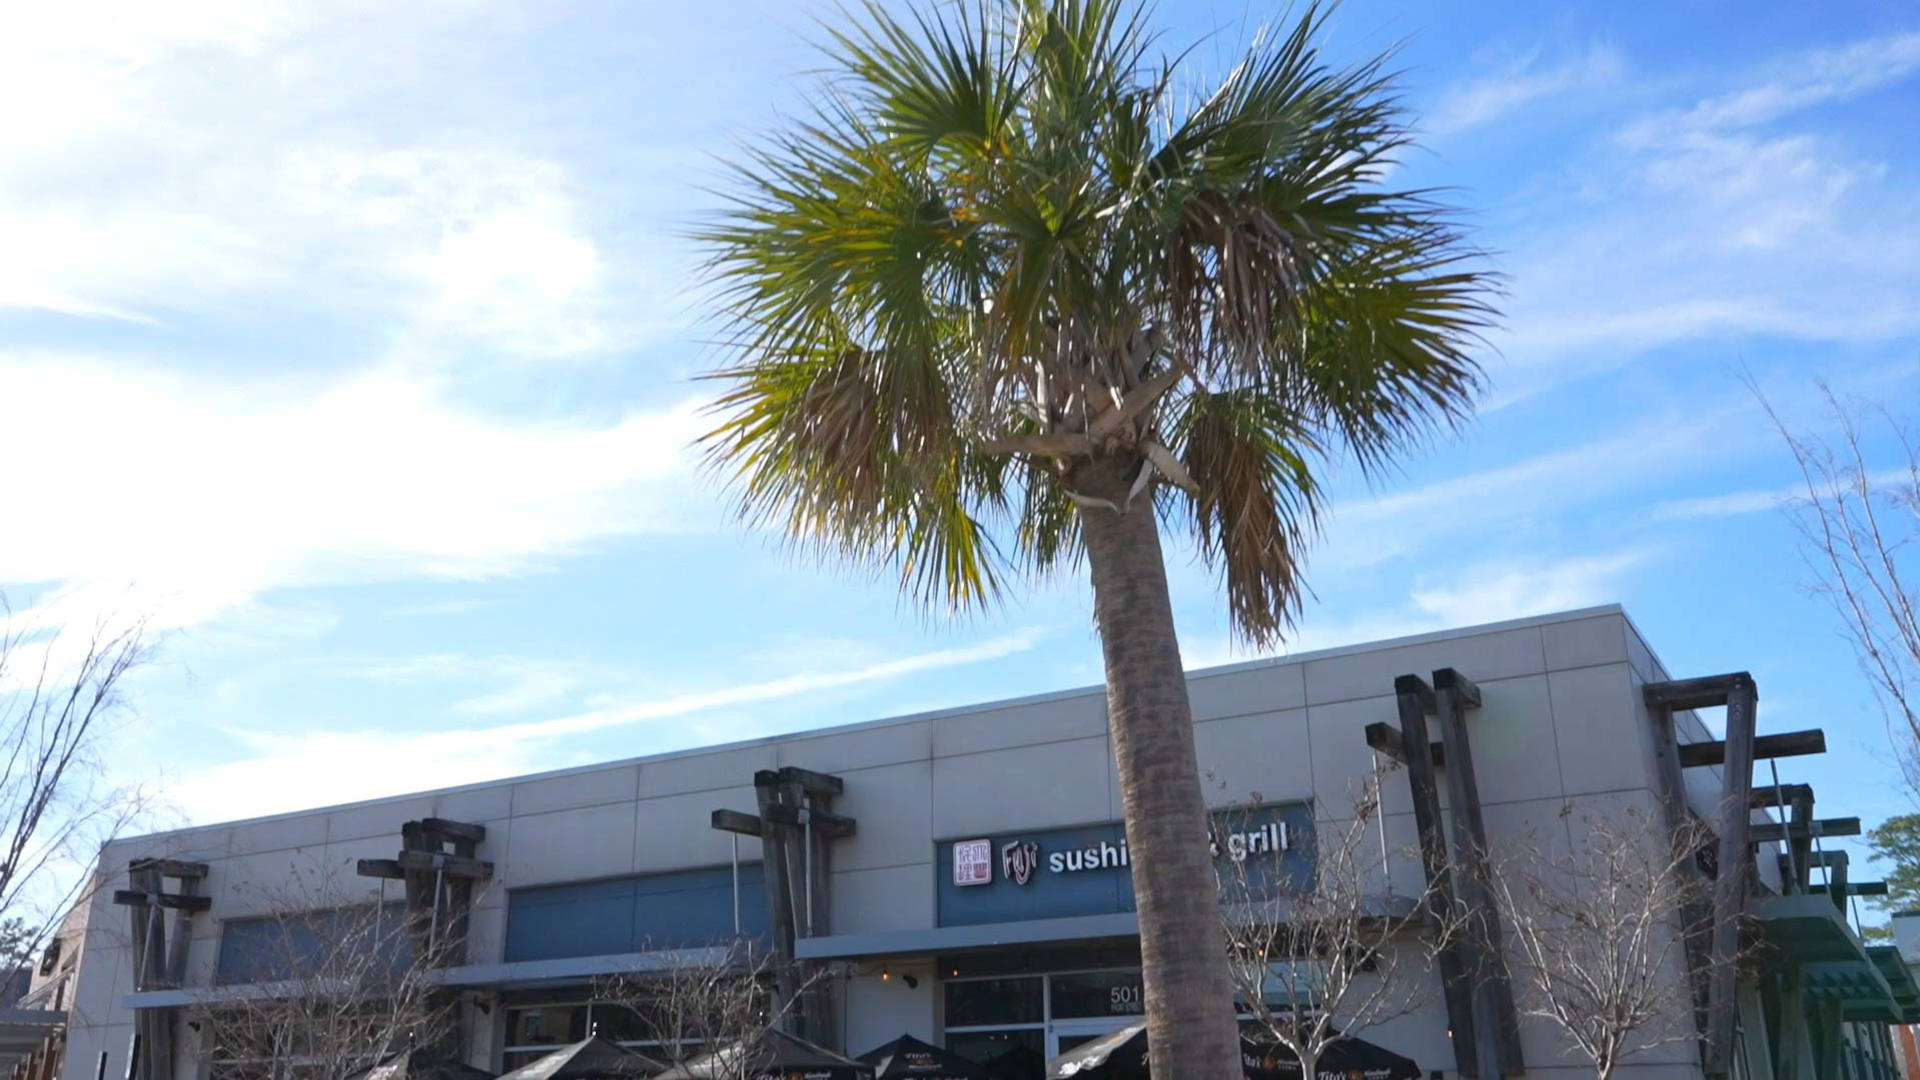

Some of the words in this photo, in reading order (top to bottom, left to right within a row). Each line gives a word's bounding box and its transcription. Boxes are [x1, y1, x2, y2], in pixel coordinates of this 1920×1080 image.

[1049, 838, 1128, 873] sushi
[1227, 821, 1289, 863] grill
[1111, 985, 1139, 1004] 501
